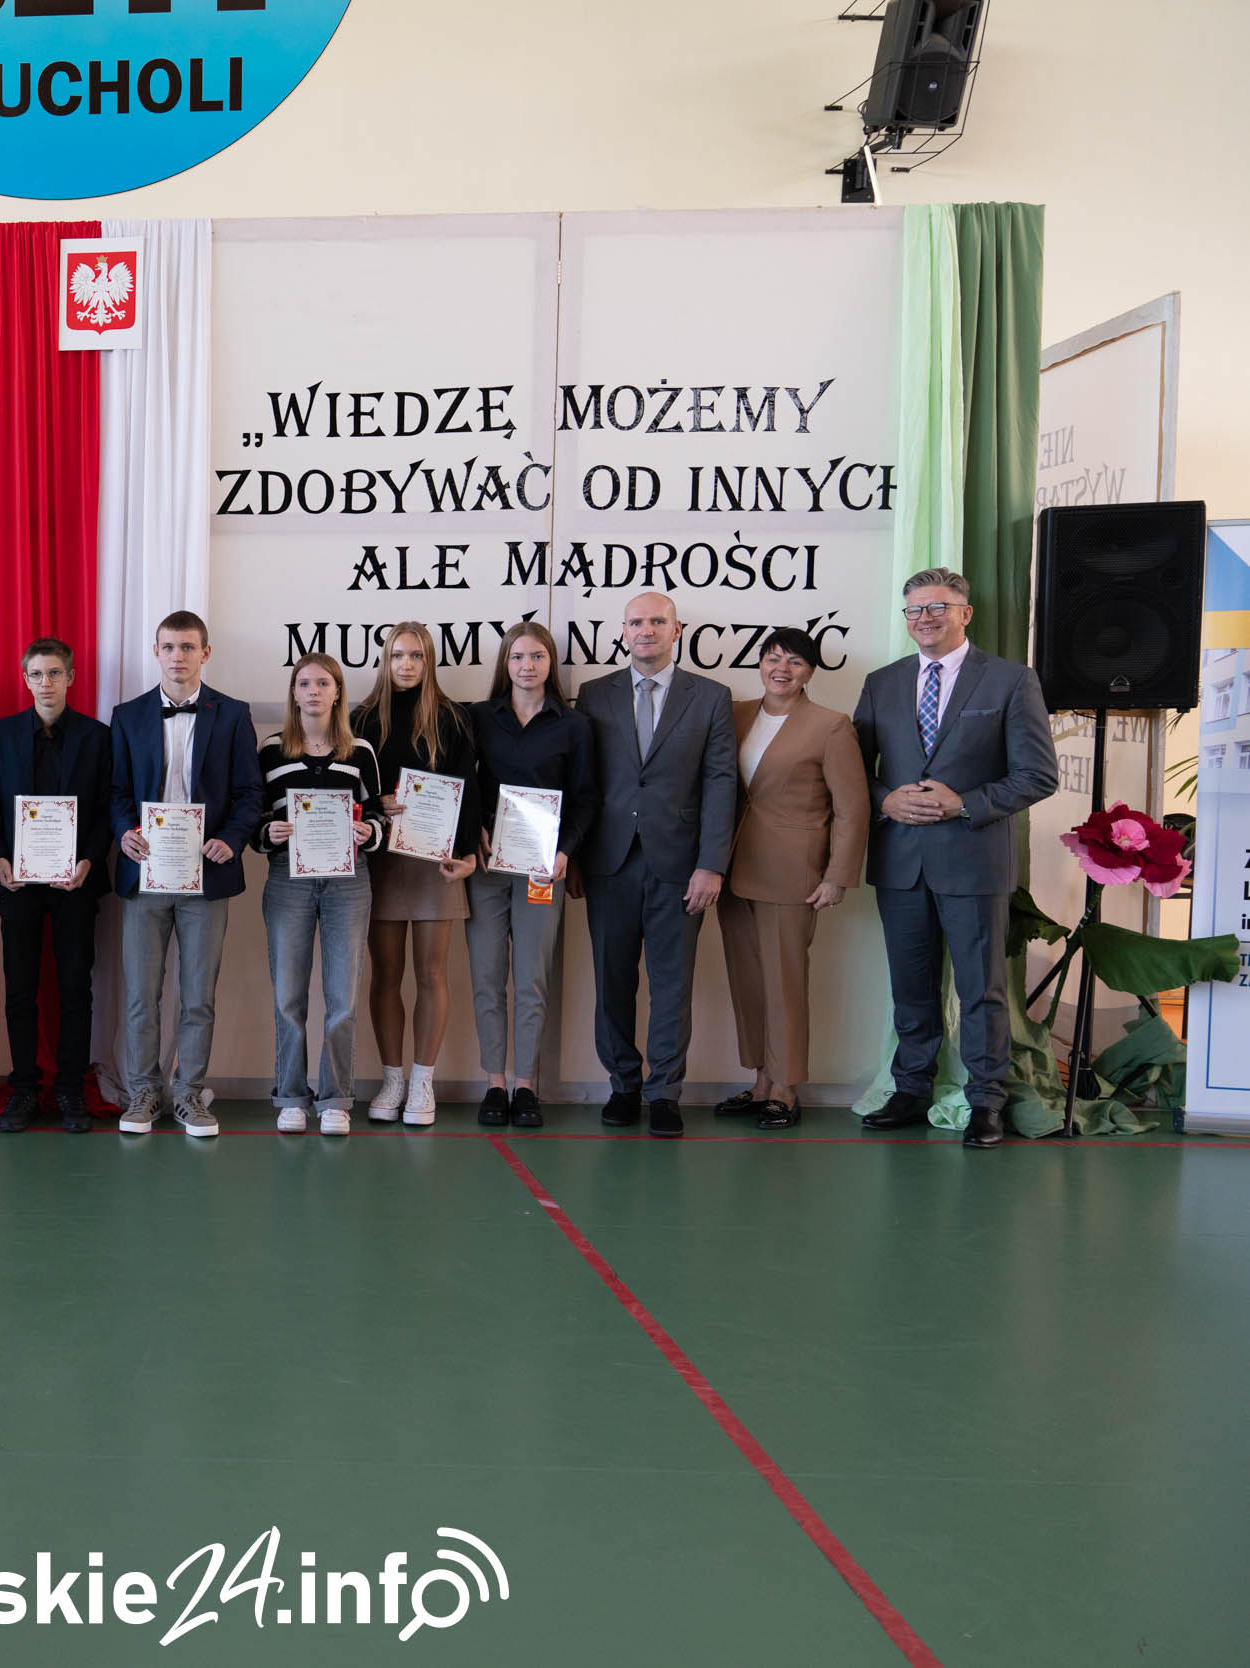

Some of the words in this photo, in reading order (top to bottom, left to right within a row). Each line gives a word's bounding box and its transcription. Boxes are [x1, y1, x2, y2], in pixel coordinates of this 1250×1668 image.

[556, 378, 837, 434] MOŻEMY
[582, 464, 662, 512] OD
[346, 543, 471, 591] ALE
[500, 530, 821, 599] MĄDROŚCI
